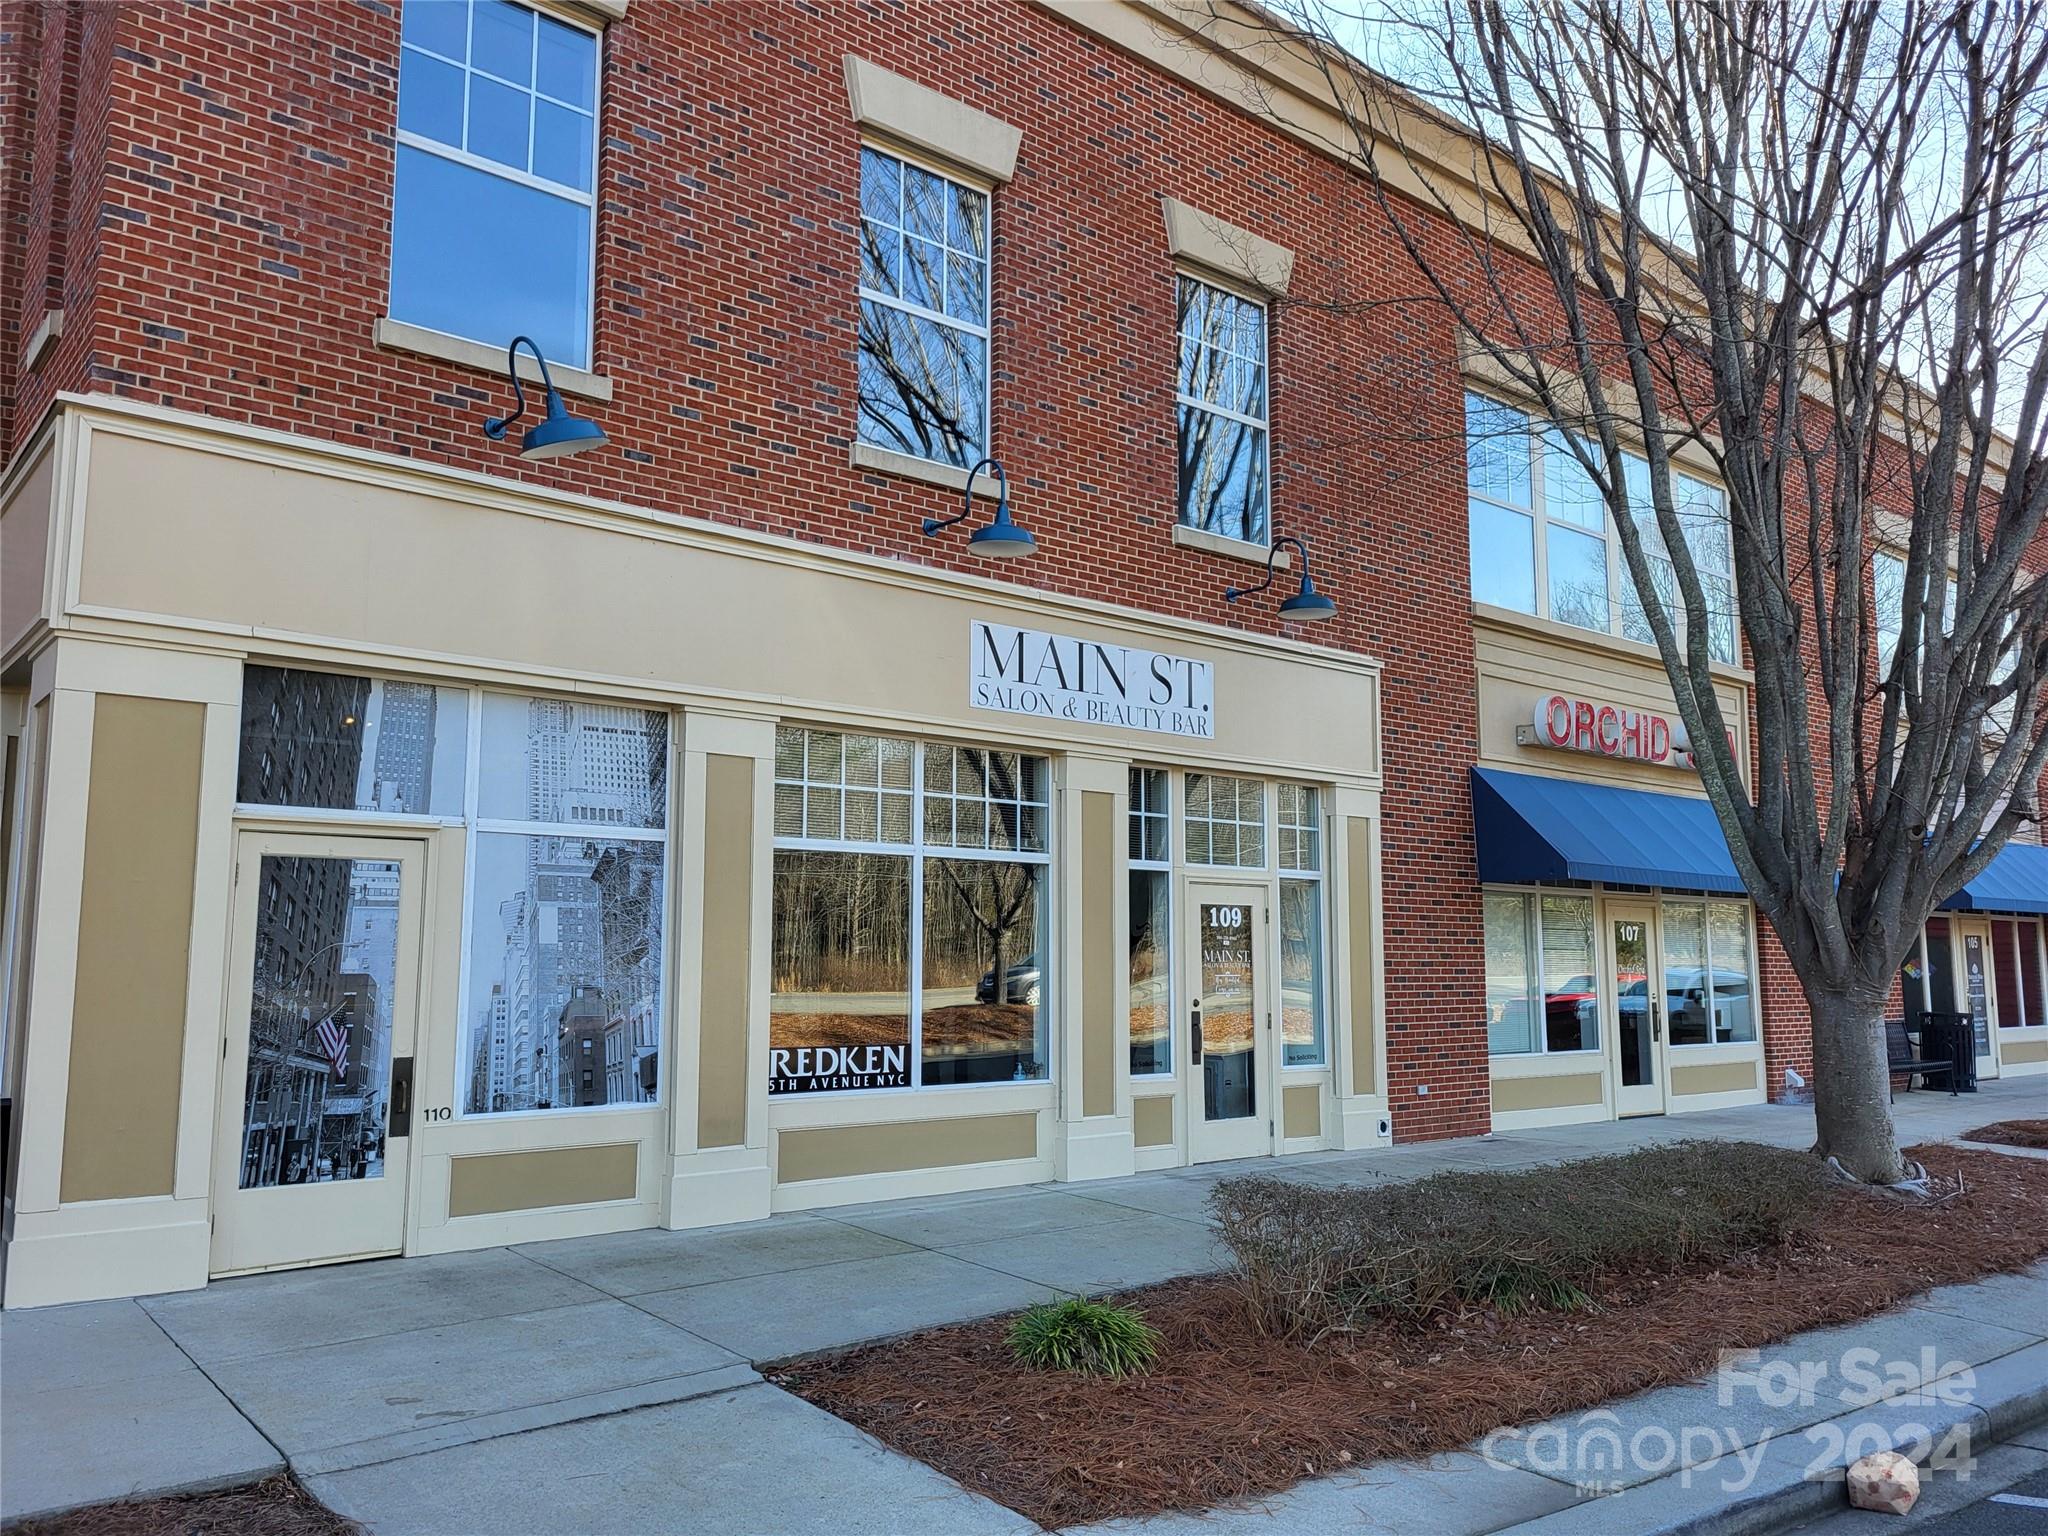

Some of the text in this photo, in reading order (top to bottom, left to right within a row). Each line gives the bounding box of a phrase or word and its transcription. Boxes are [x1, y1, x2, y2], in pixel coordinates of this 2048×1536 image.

[977, 624, 1209, 712] MAIN ST.
[977, 683, 1208, 737] SALON & BEAUTY BAR
[1547, 695, 1670, 763] ORCHID
[1209, 907, 1242, 928] 109
[1619, 925, 1640, 942] 107
[1967, 936, 1979, 949] 105
[1204, 950, 1251, 963] MAIN ST.
[769, 1045, 906, 1079] REDKEN
[769, 1074, 905, 1092] 5TH AVENUE NYC
[424, 1107, 452, 1122] 110
